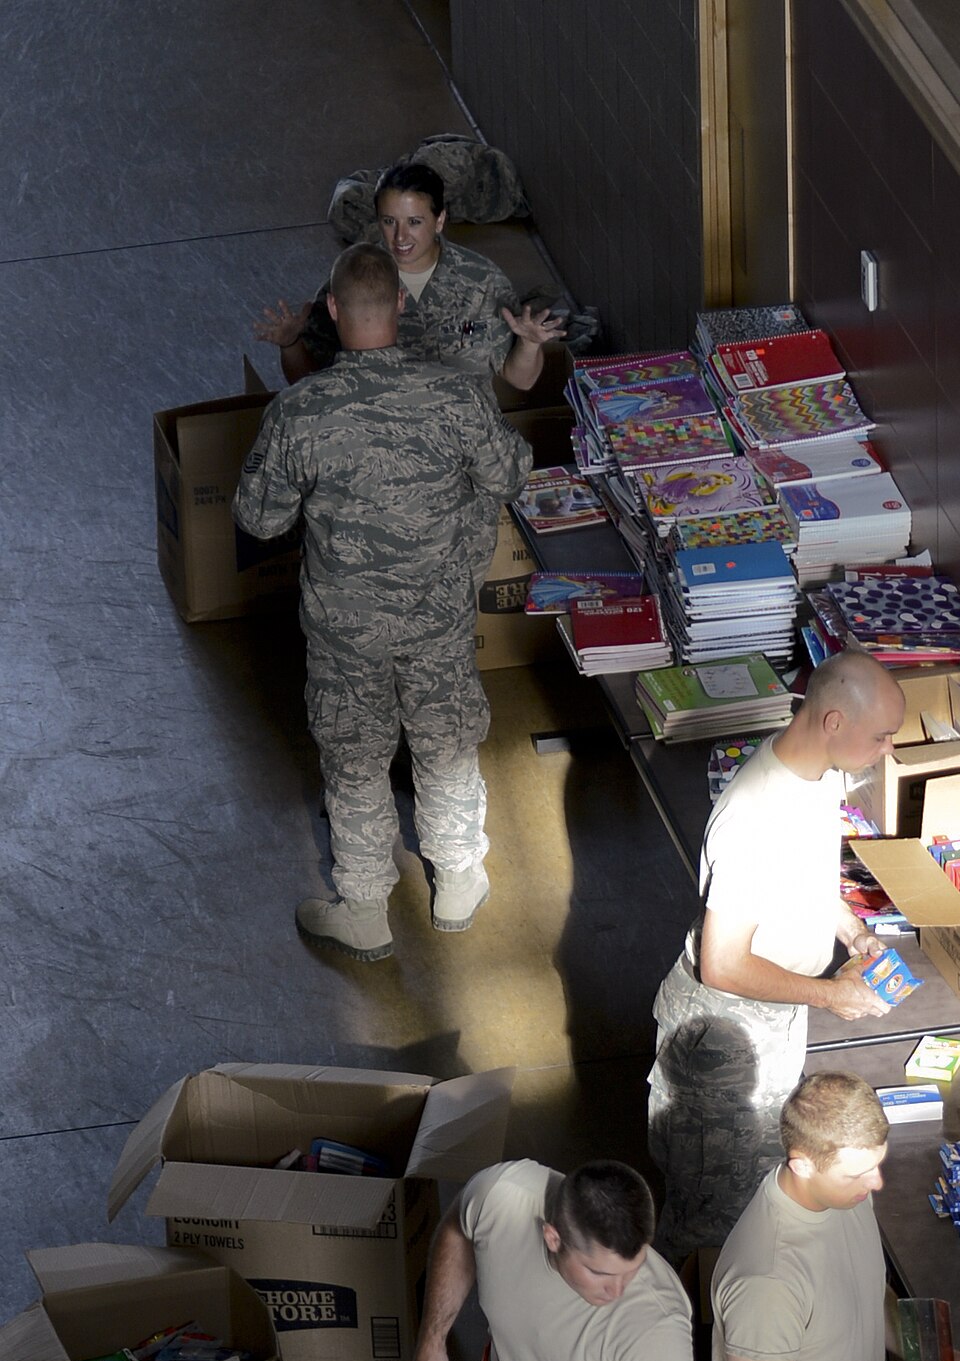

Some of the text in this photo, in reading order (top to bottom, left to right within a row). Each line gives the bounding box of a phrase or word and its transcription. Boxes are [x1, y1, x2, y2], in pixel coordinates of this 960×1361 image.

[174, 1231, 245, 1249] 2 PLY TOWELS
[265, 1290, 336, 1305] HOME
[266, 1305, 337, 1321] TORE
